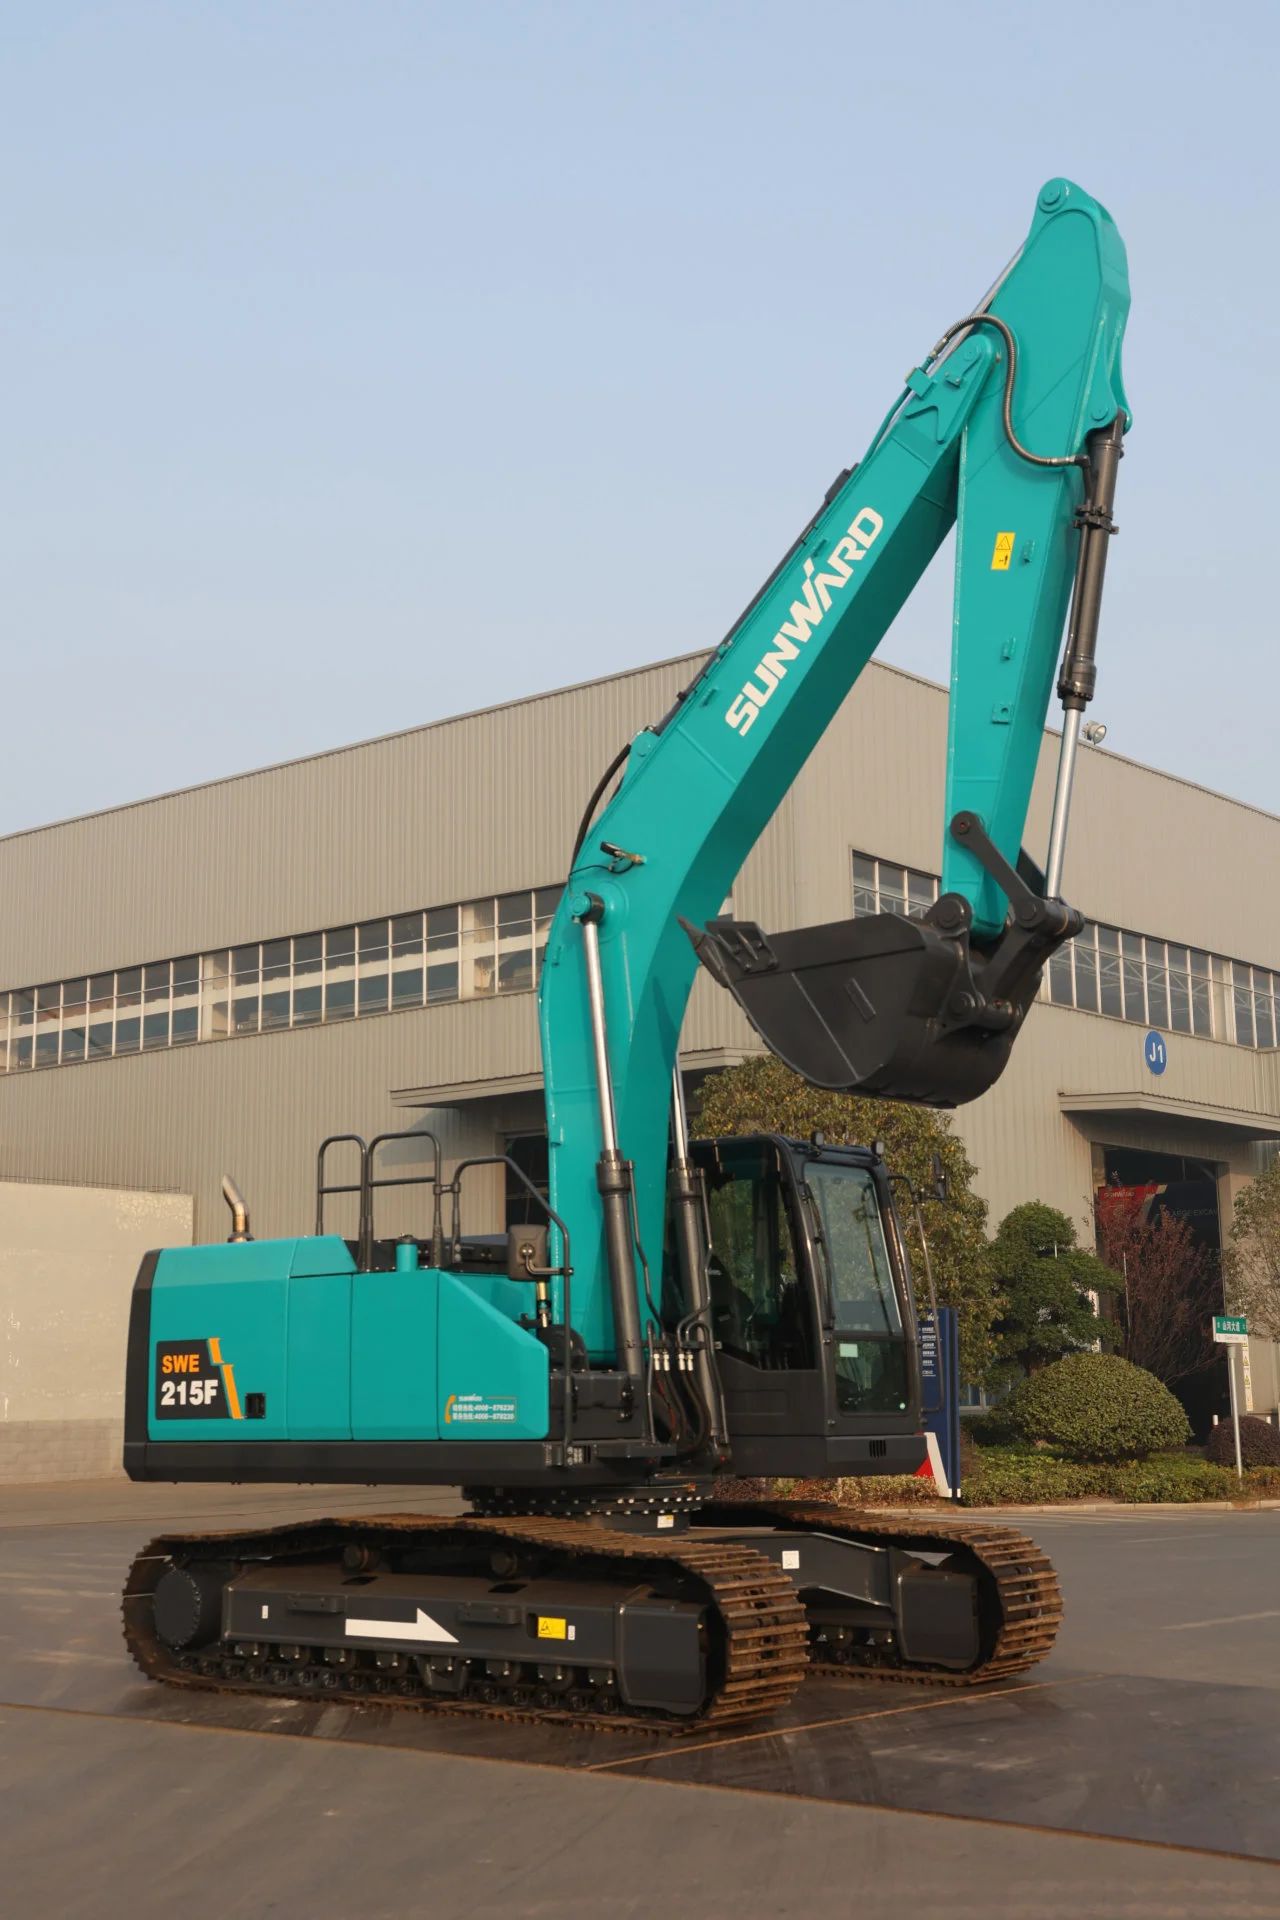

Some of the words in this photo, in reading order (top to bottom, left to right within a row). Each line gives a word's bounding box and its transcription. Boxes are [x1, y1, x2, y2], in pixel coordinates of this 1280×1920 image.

[724, 506, 884, 737] SUNWARD
[1149, 1041, 1164, 1064] J1
[162, 1354, 200, 1373] SWE
[160, 1379, 219, 1406] 215F
